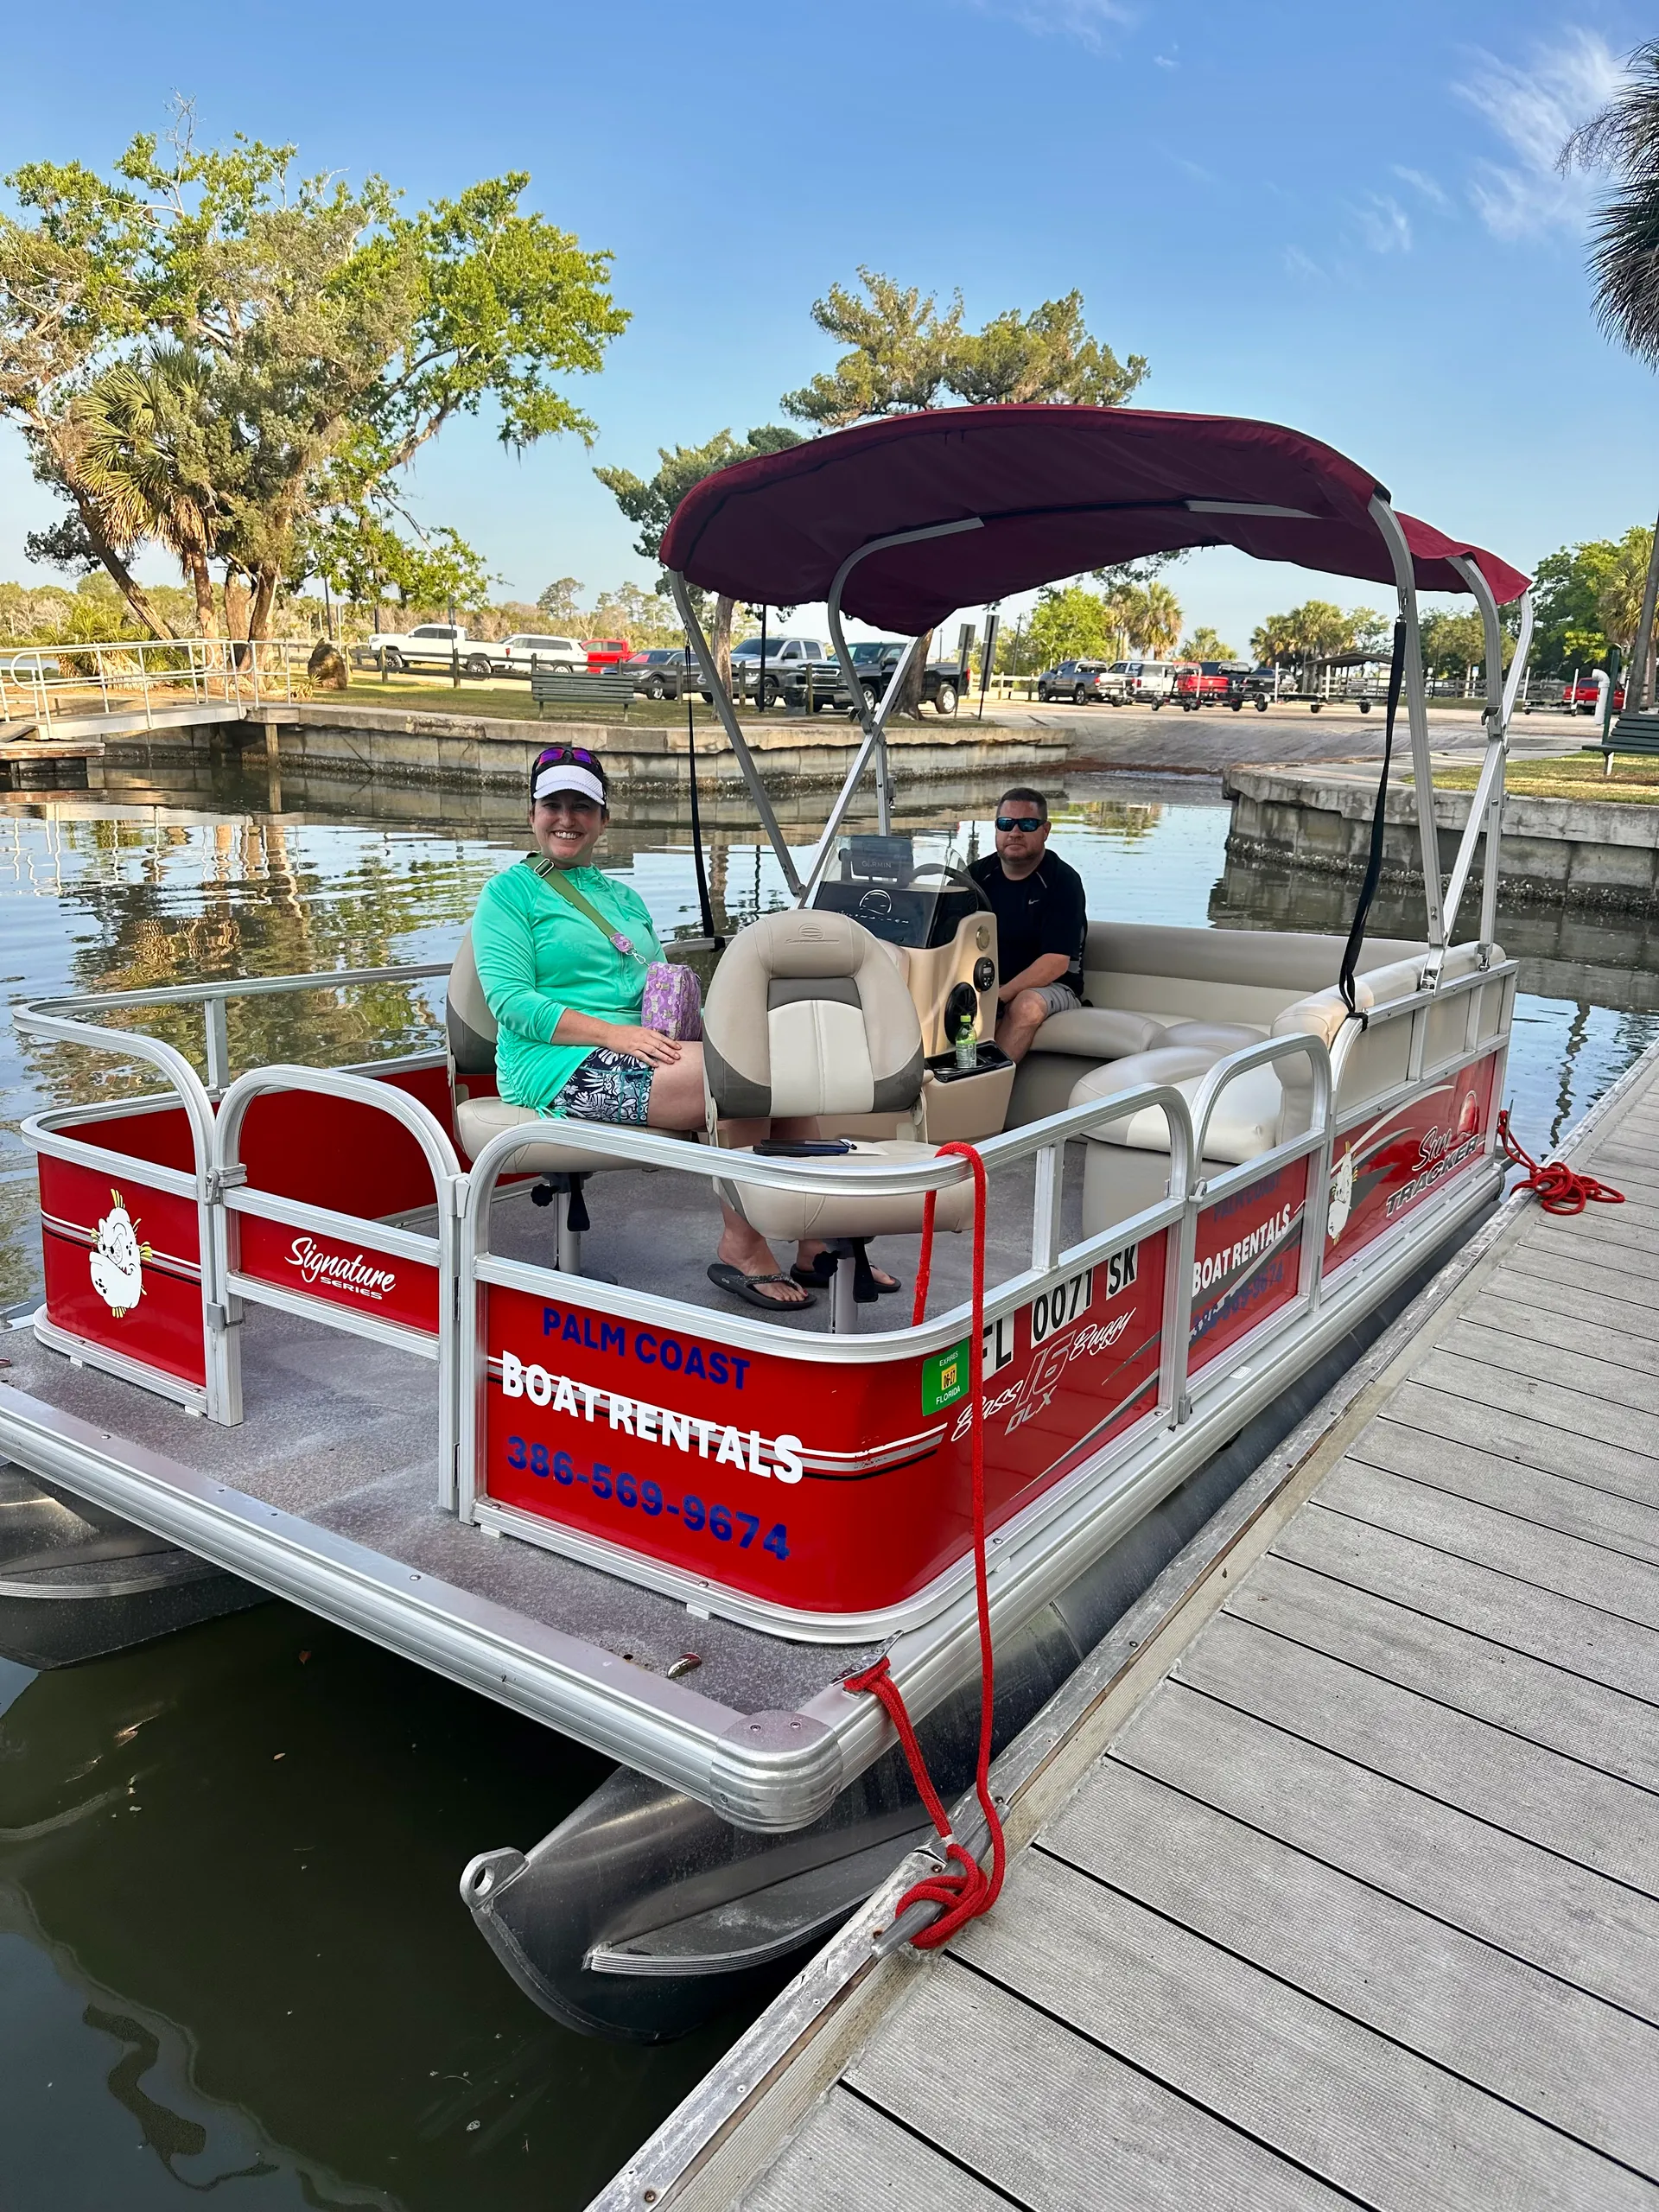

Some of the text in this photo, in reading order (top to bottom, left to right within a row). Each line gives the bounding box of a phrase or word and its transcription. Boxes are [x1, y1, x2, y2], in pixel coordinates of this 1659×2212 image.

[1386, 1134, 1479, 1217] TRACKER
[1412, 1126, 1452, 1171] Sun
[284, 1236, 396, 1292] Signature
[1192, 1203, 1291, 1298] BOAT RENTALS
[320, 1276, 383, 1300] SERIES
[1033, 1268, 1093, 1342] 0071
[1109, 1243, 1136, 1295] SK
[543, 1306, 750, 1389] PALM COAST
[939, 1351, 958, 1367] EXPIRES
[1069, 1307, 1136, 1362] Buggy
[502, 1350, 804, 1484] BOAT RENTALS
[936, 1385, 961, 1405] FLORIDA
[1004, 1385, 1057, 1436] DLX
[507, 1435, 790, 1560] 386-569-9674
